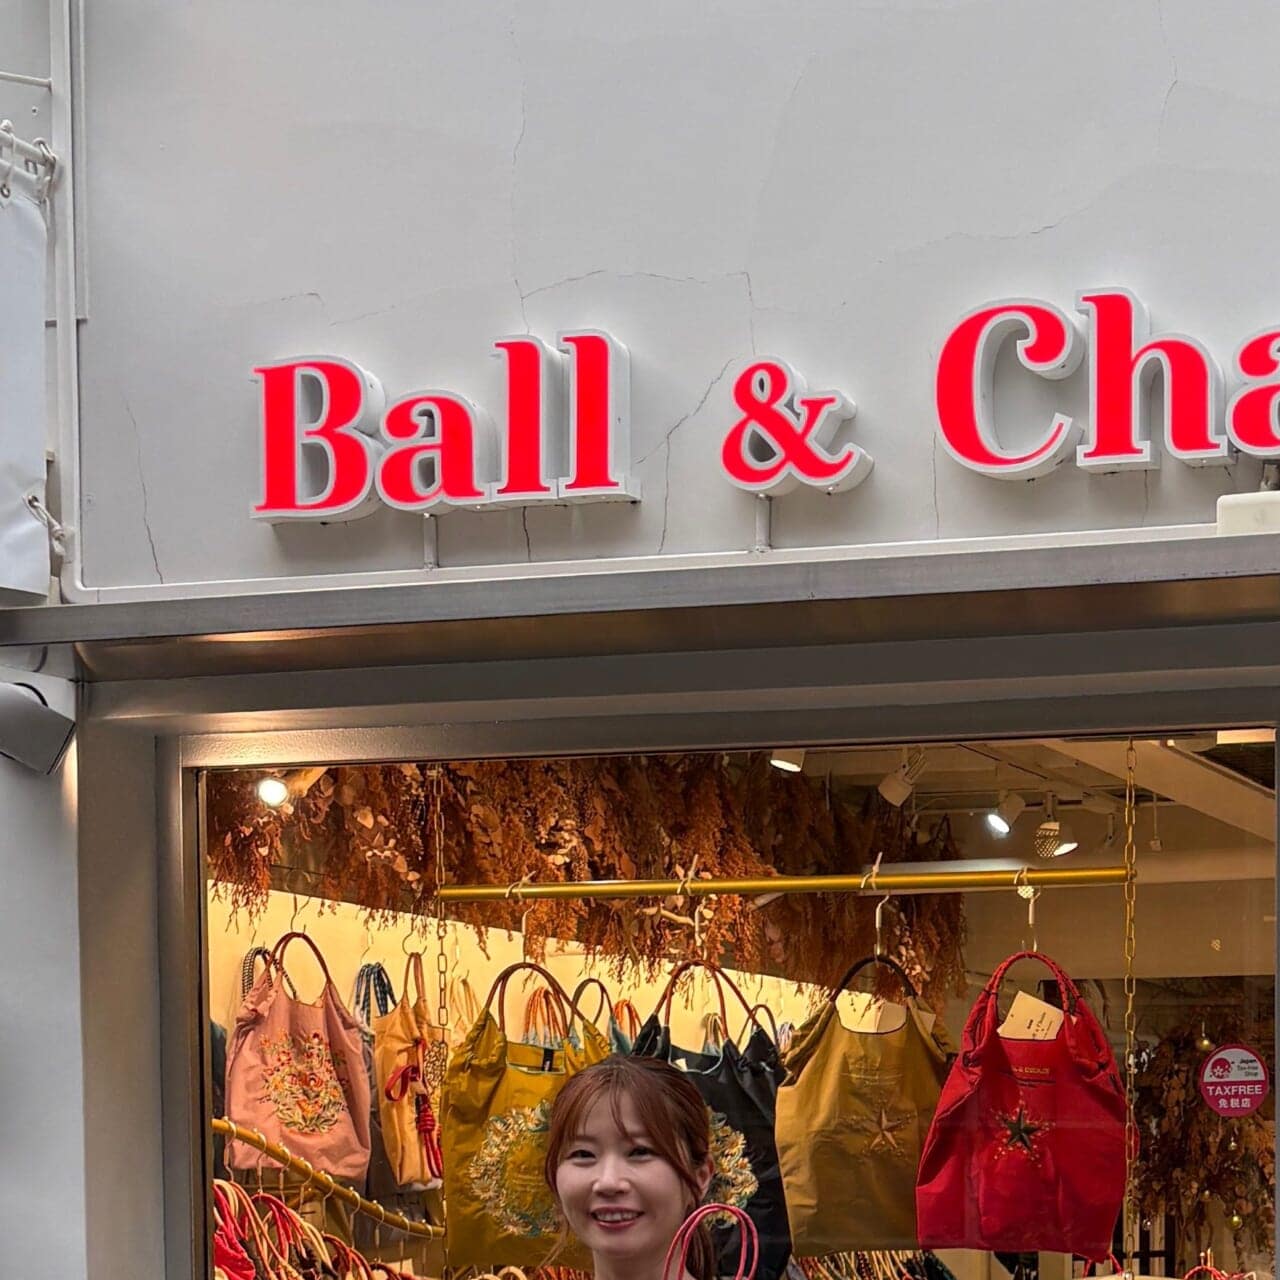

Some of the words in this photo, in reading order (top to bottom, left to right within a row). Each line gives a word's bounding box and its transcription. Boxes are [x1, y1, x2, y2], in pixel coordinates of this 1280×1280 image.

[254, 333, 624, 511] Ball
[721, 362, 858, 483] &
[1207, 1085, 1262, 1096] TAXFREE
